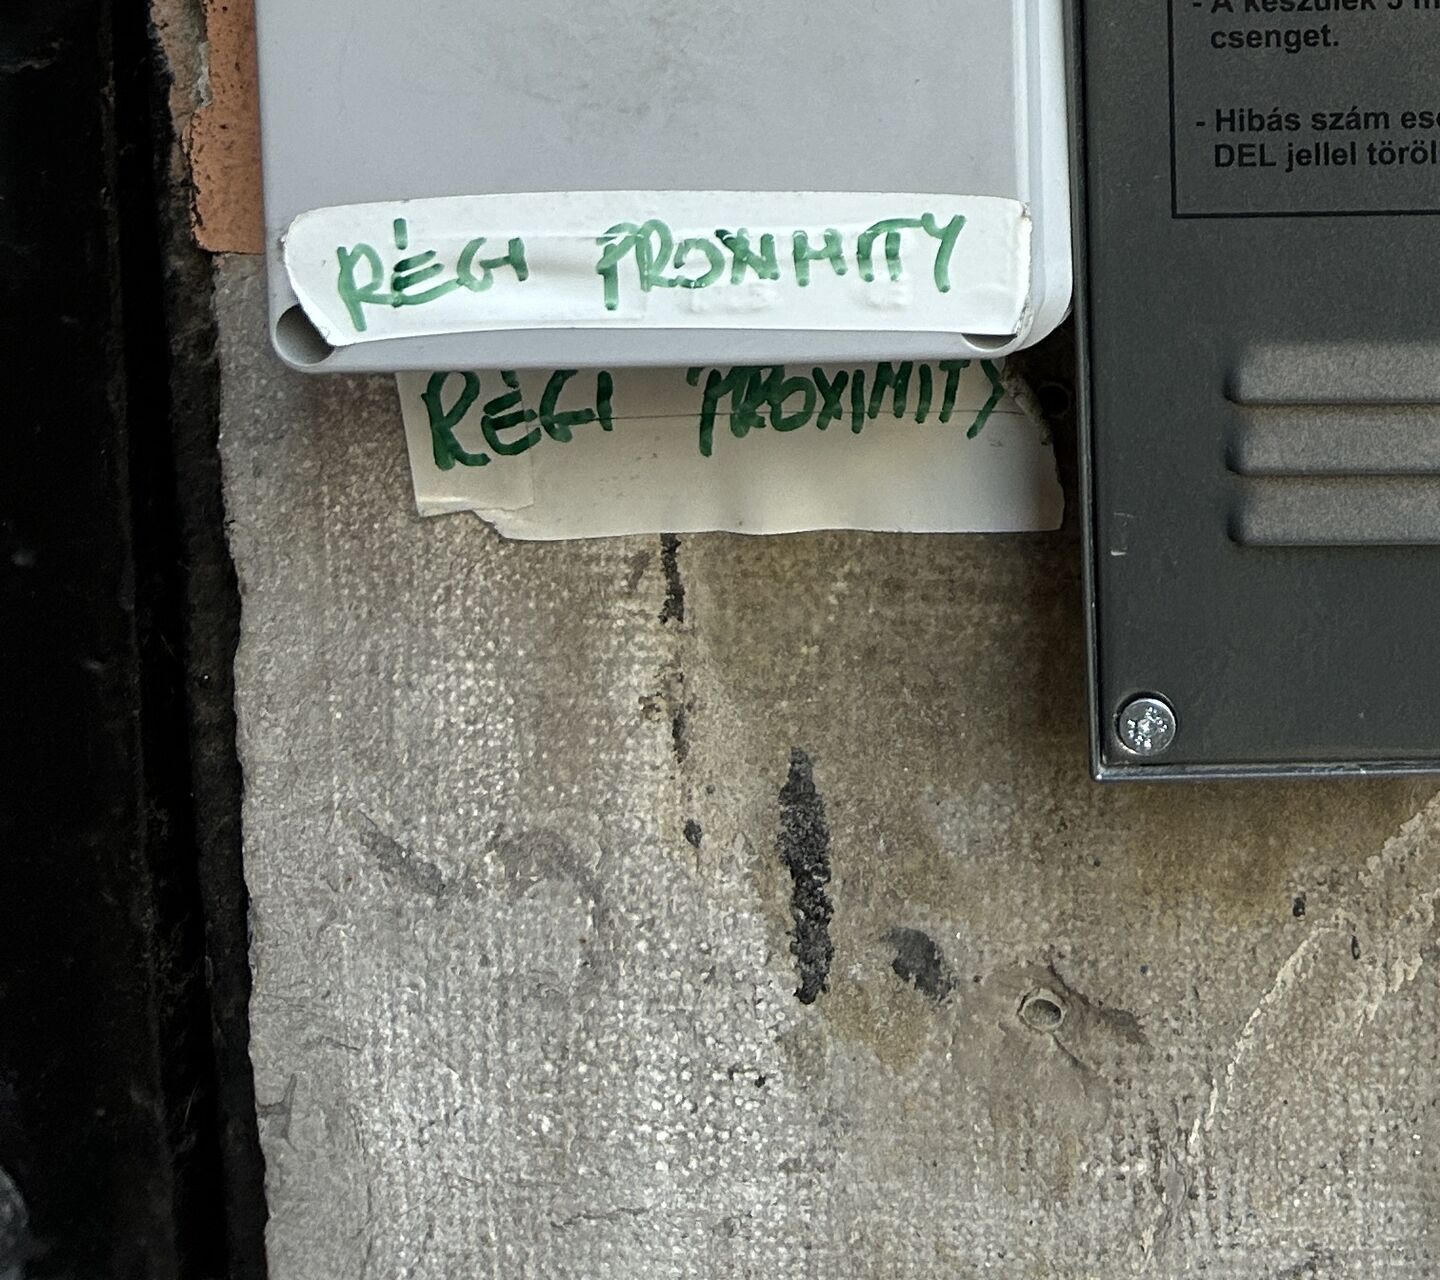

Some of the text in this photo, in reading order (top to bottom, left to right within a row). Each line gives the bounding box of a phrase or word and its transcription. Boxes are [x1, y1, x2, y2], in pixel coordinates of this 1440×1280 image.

[1210, 24, 1340, 55] csenget.
[1215, 106, 1301, 133] Hibás
[1311, 105, 1390, 132] szám
[1214, 143, 1277, 168] DEL
[1284, 141, 1357, 174] jellel
